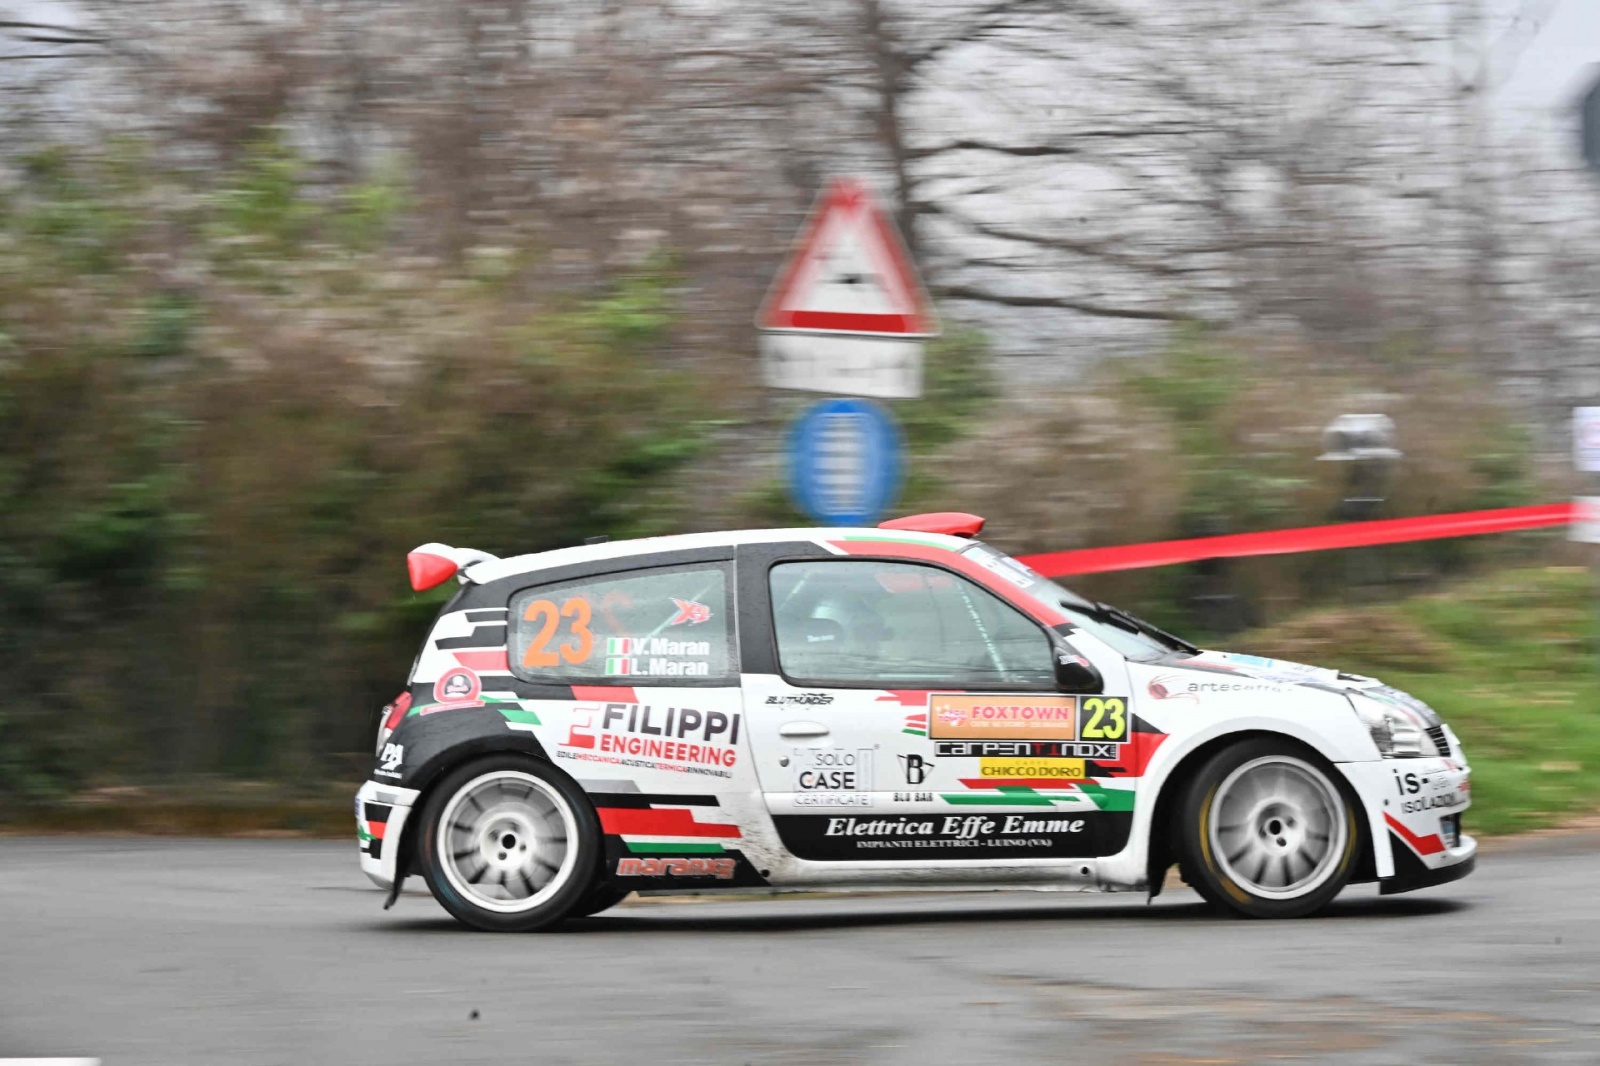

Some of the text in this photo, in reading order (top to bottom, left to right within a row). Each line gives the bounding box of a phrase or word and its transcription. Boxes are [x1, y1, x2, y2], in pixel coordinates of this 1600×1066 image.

[522, 597, 593, 667] 23
[972, 706, 1068, 719] FOXTOWN
[1081, 698, 1125, 739] 23
[602, 703, 740, 745] FILIPPI
[600, 734, 737, 767] ENGINEERING
[815, 753, 855, 766] SOLO
[907, 754, 925, 784] B
[981, 766, 1036, 776] CHICCO
[799, 771, 855, 789] CASE
[794, 794, 869, 806] CERTIFICATE
[825, 815, 1085, 840] Elettrica Effe Emme
[856, 840, 913, 849] IMPIANTI
[914, 839, 979, 848] ELETTRICI
[987, 839, 1027, 847] LUINO
